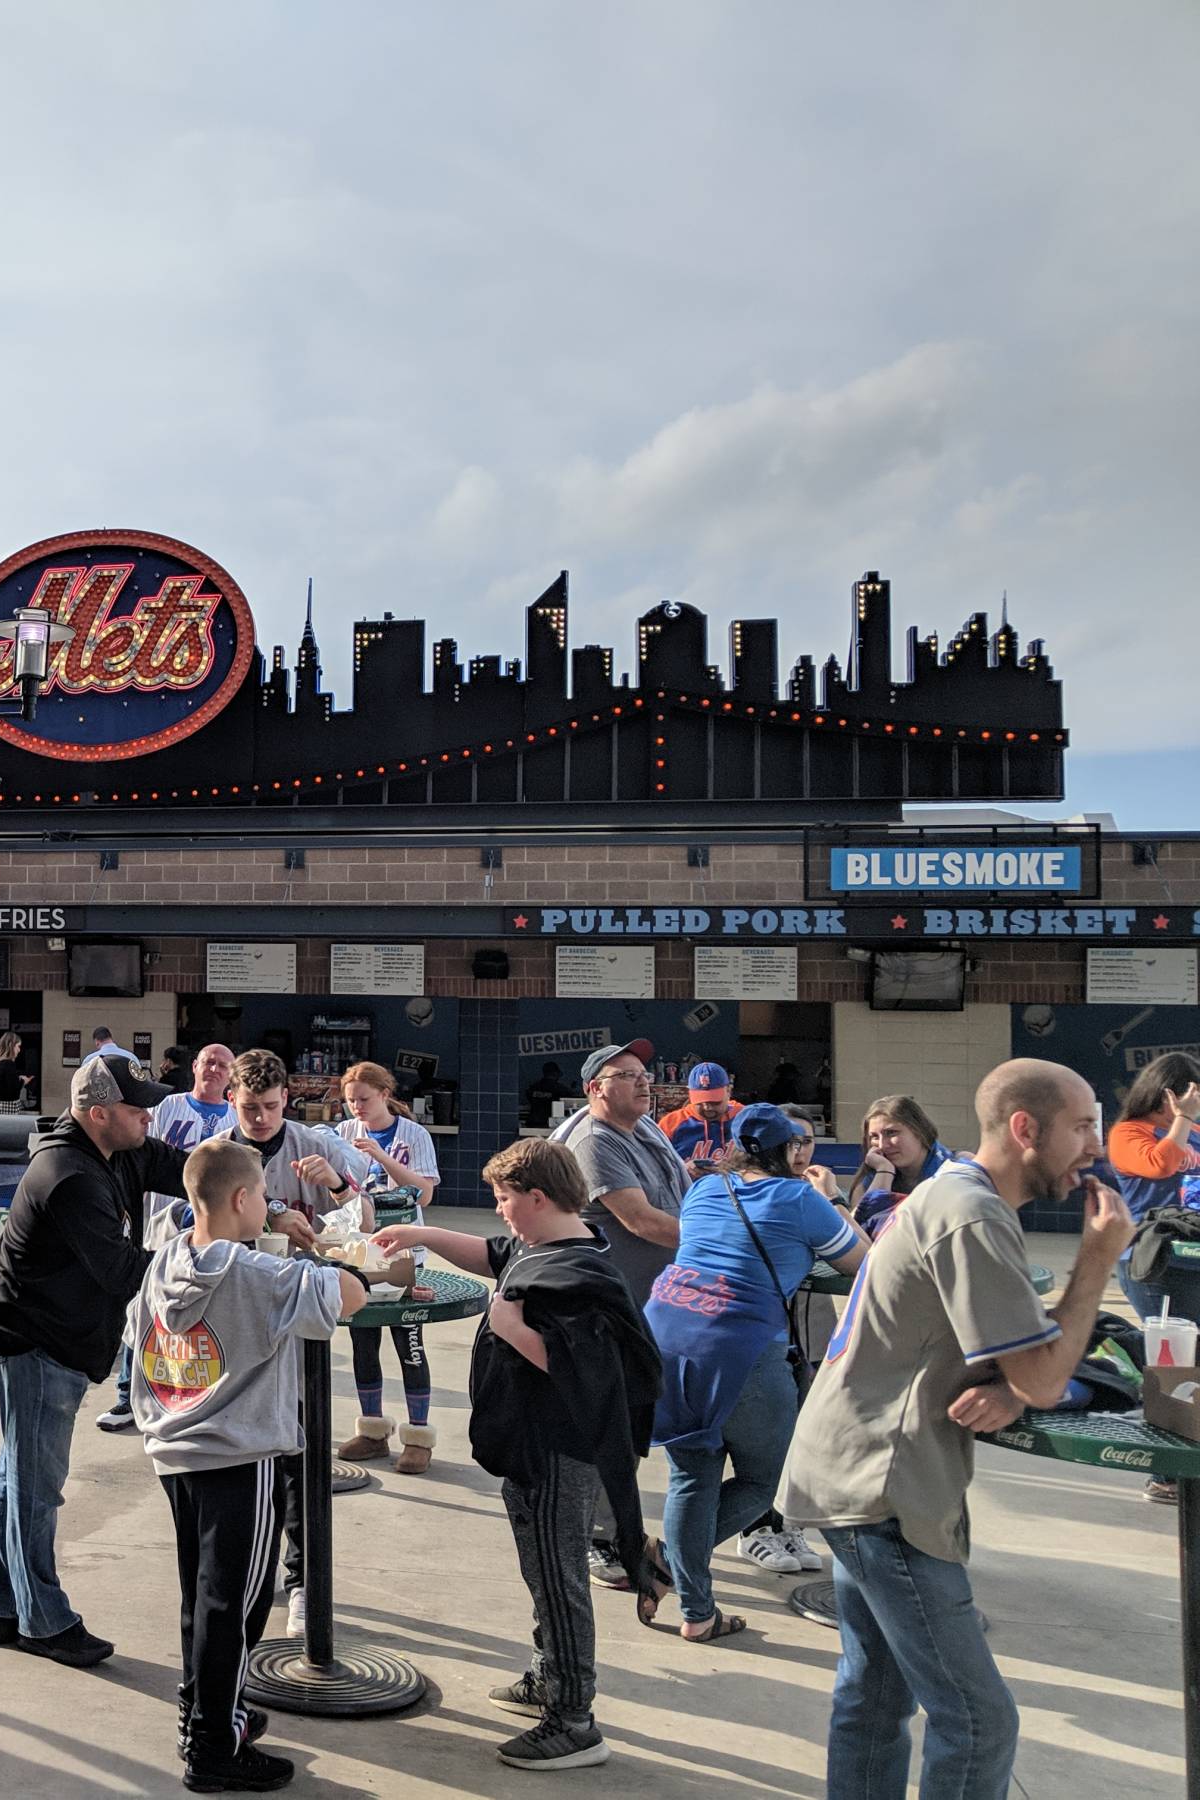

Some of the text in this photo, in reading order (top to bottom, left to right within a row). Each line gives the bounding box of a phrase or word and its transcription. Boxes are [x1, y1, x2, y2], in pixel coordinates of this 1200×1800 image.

[847, 853, 1065, 886] BLUESMOKE
[541, 909, 847, 934] PULLED PORK
[923, 909, 1136, 935] BRISKET
[520, 1030, 604, 1052] UESMOKE
[685, 1139, 735, 1161] Met
[401, 1308, 430, 1322] Coca-Cola
[154, 1334, 212, 1360] MYRTLE
[153, 1357, 211, 1387] BEACH
[1100, 1446, 1153, 1468] Coca-Cola
